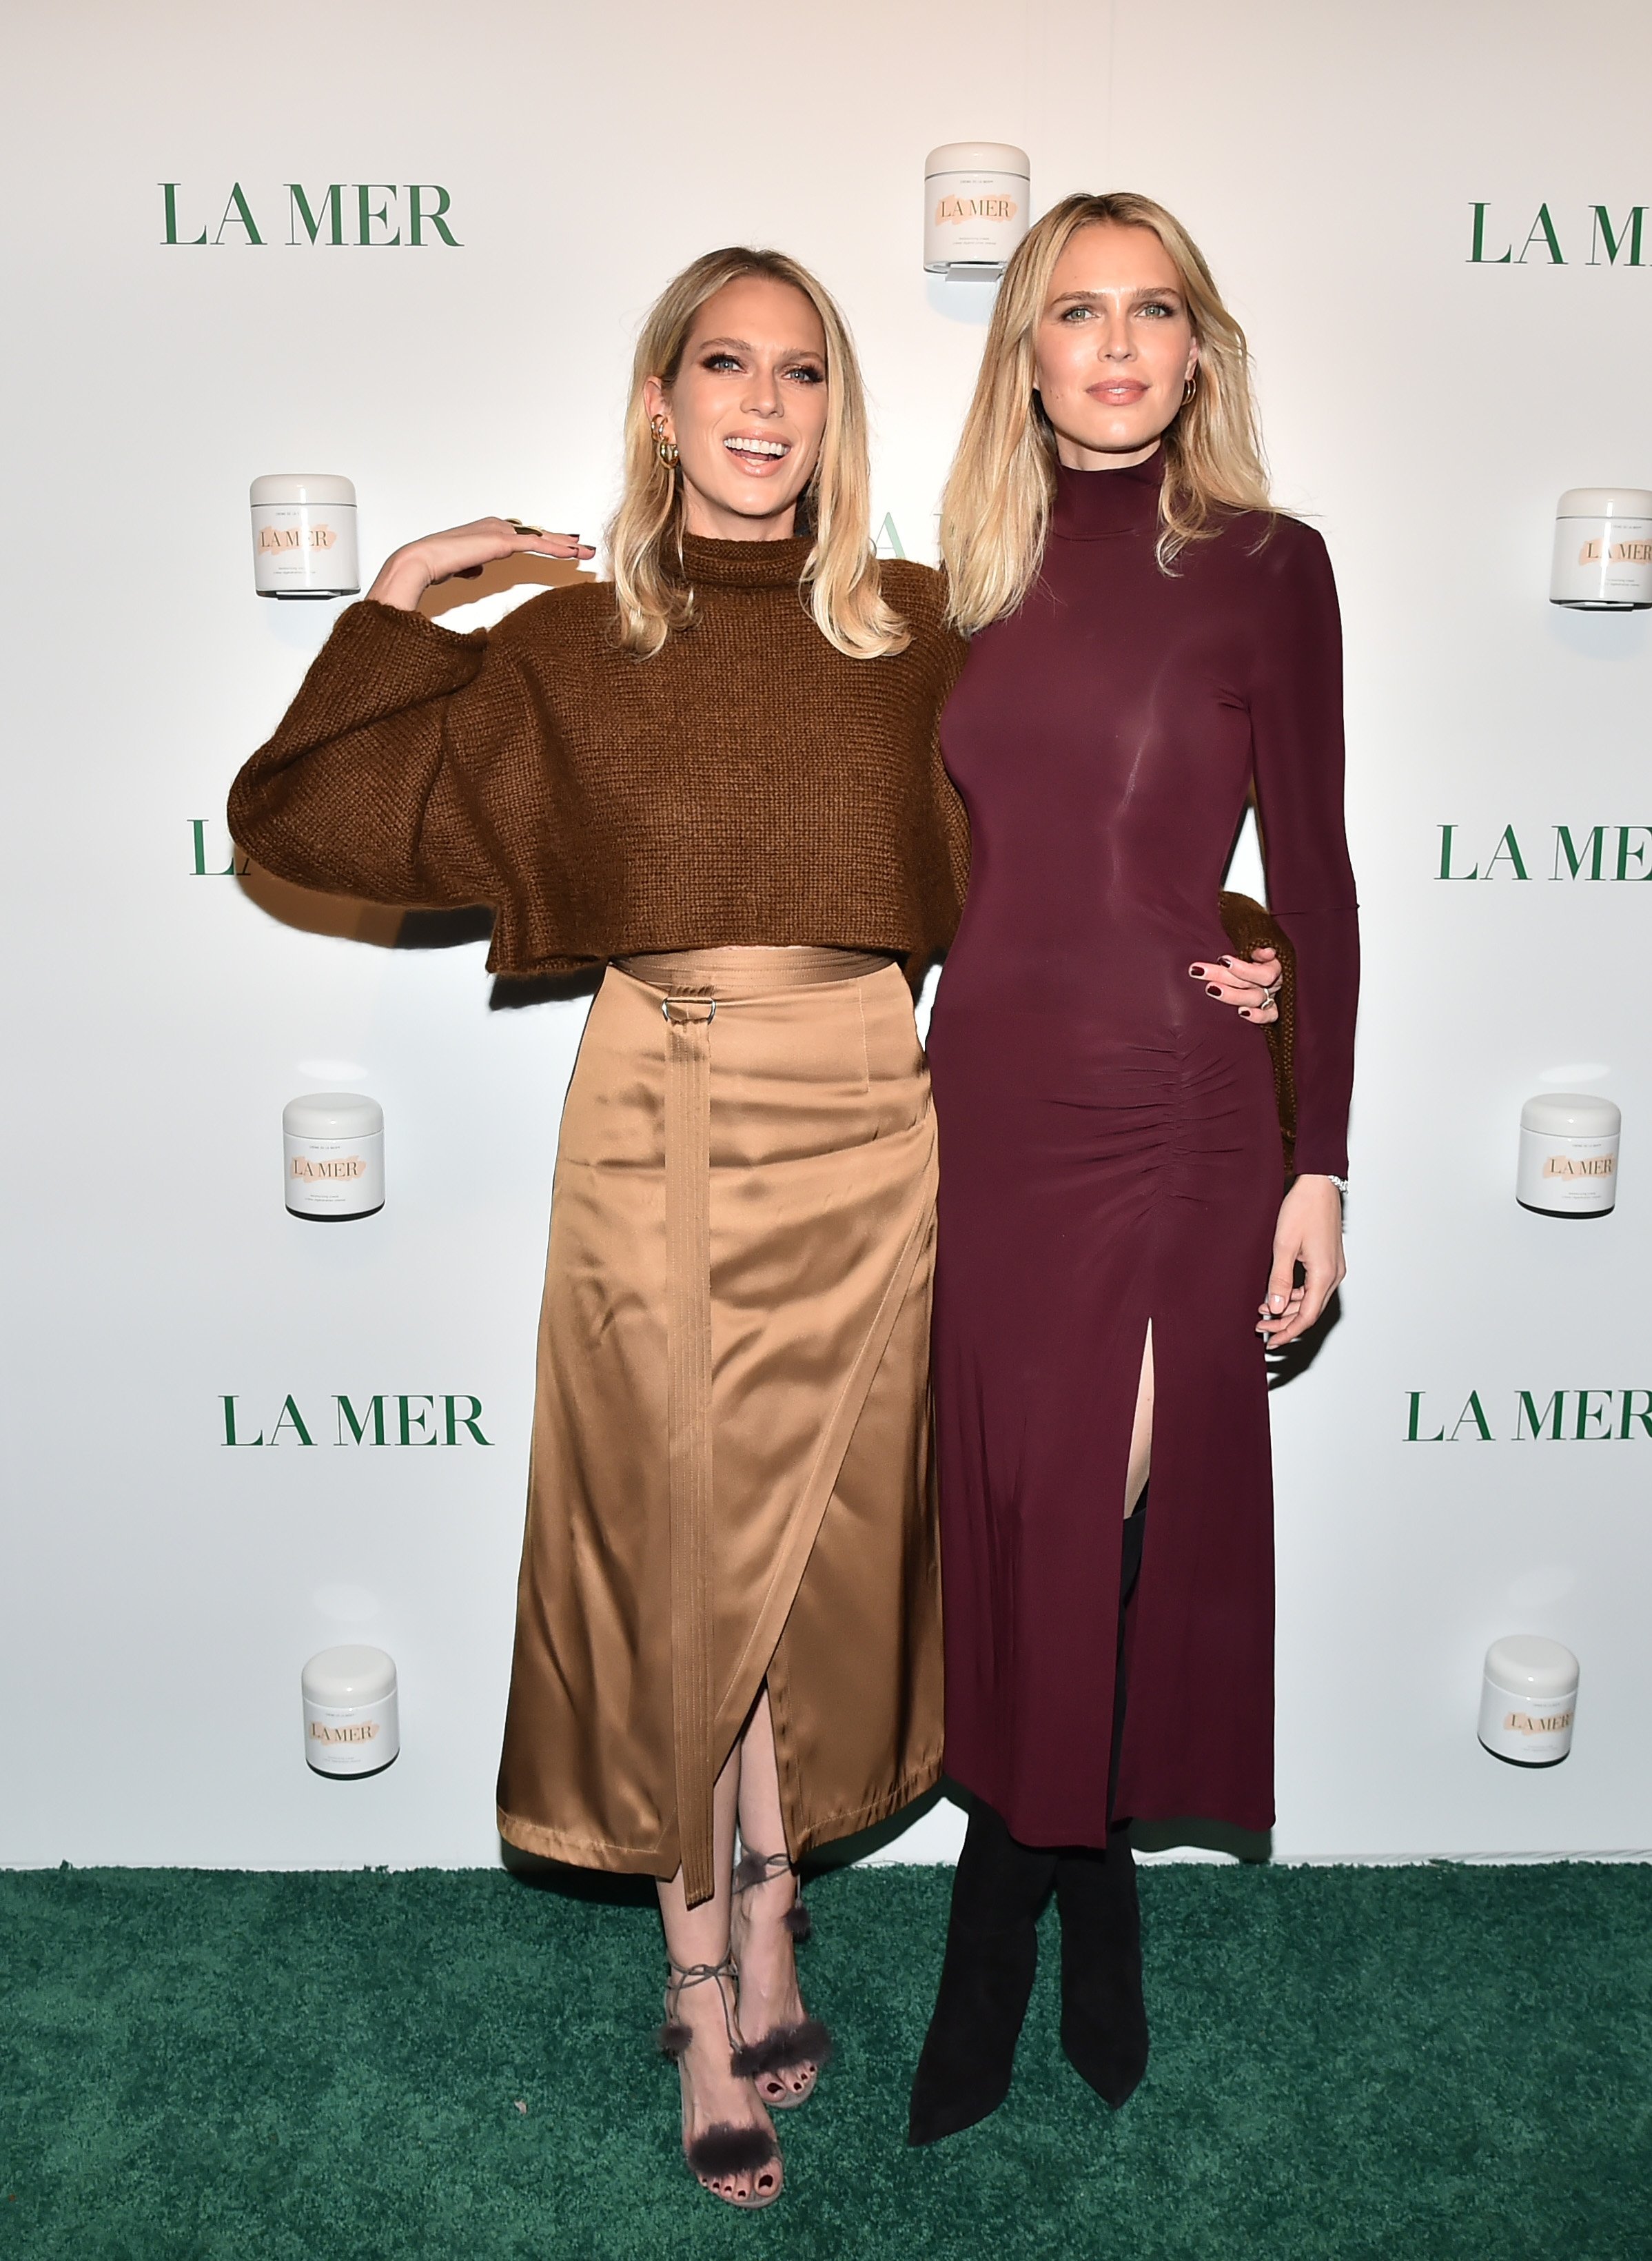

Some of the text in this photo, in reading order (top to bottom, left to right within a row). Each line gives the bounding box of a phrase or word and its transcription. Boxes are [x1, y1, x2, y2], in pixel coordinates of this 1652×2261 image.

[157, 181, 465, 247] LA MER
[941, 199, 1009, 217] LA MER
[1465, 202, 1652, 266] LA M
[261, 531, 281, 547] LA
[875, 511, 907, 560] A
[1618, 543, 1652, 560] MER
[186, 818, 251, 876] L
[1433, 823, 1533, 881] LA
[294, 1159, 358, 1177] LA MER
[1550, 1158, 1612, 1175] LA MER
[218, 1393, 496, 1447] LA MER
[1402, 1389, 1652, 1442] LA MER
[311, 1723, 371, 1742] LA MER
[1511, 1713, 1570, 1731] LA MER
